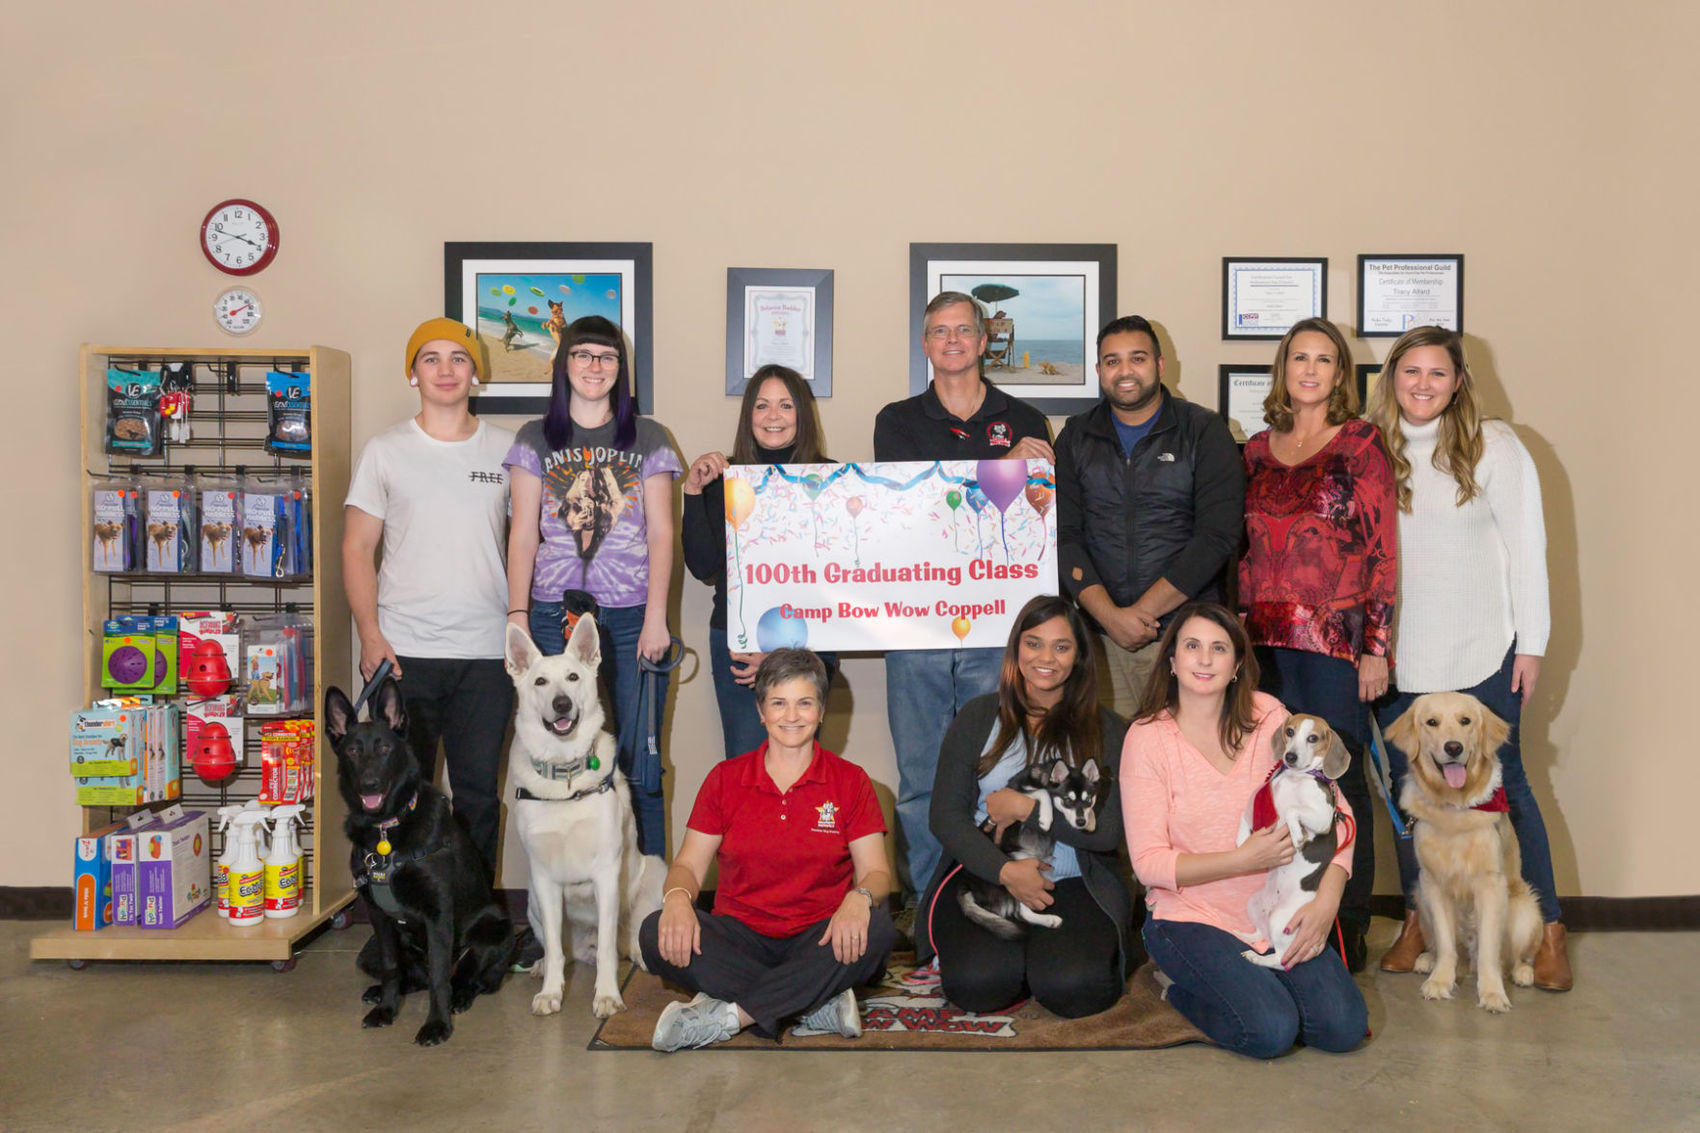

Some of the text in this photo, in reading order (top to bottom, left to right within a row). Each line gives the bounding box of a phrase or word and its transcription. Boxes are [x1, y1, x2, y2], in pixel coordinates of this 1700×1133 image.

[234, 210, 242, 218] 12
[256, 221, 262, 229] 2
[212, 233, 218, 241] 9
[216, 245, 222, 253] 8
[543, 448, 583, 473] ANIS
[469, 471, 504, 484] FREE
[746, 559, 1039, 586] 100th Graduating Class
[780, 600, 1006, 622] Camp Bow Wow Coppell
